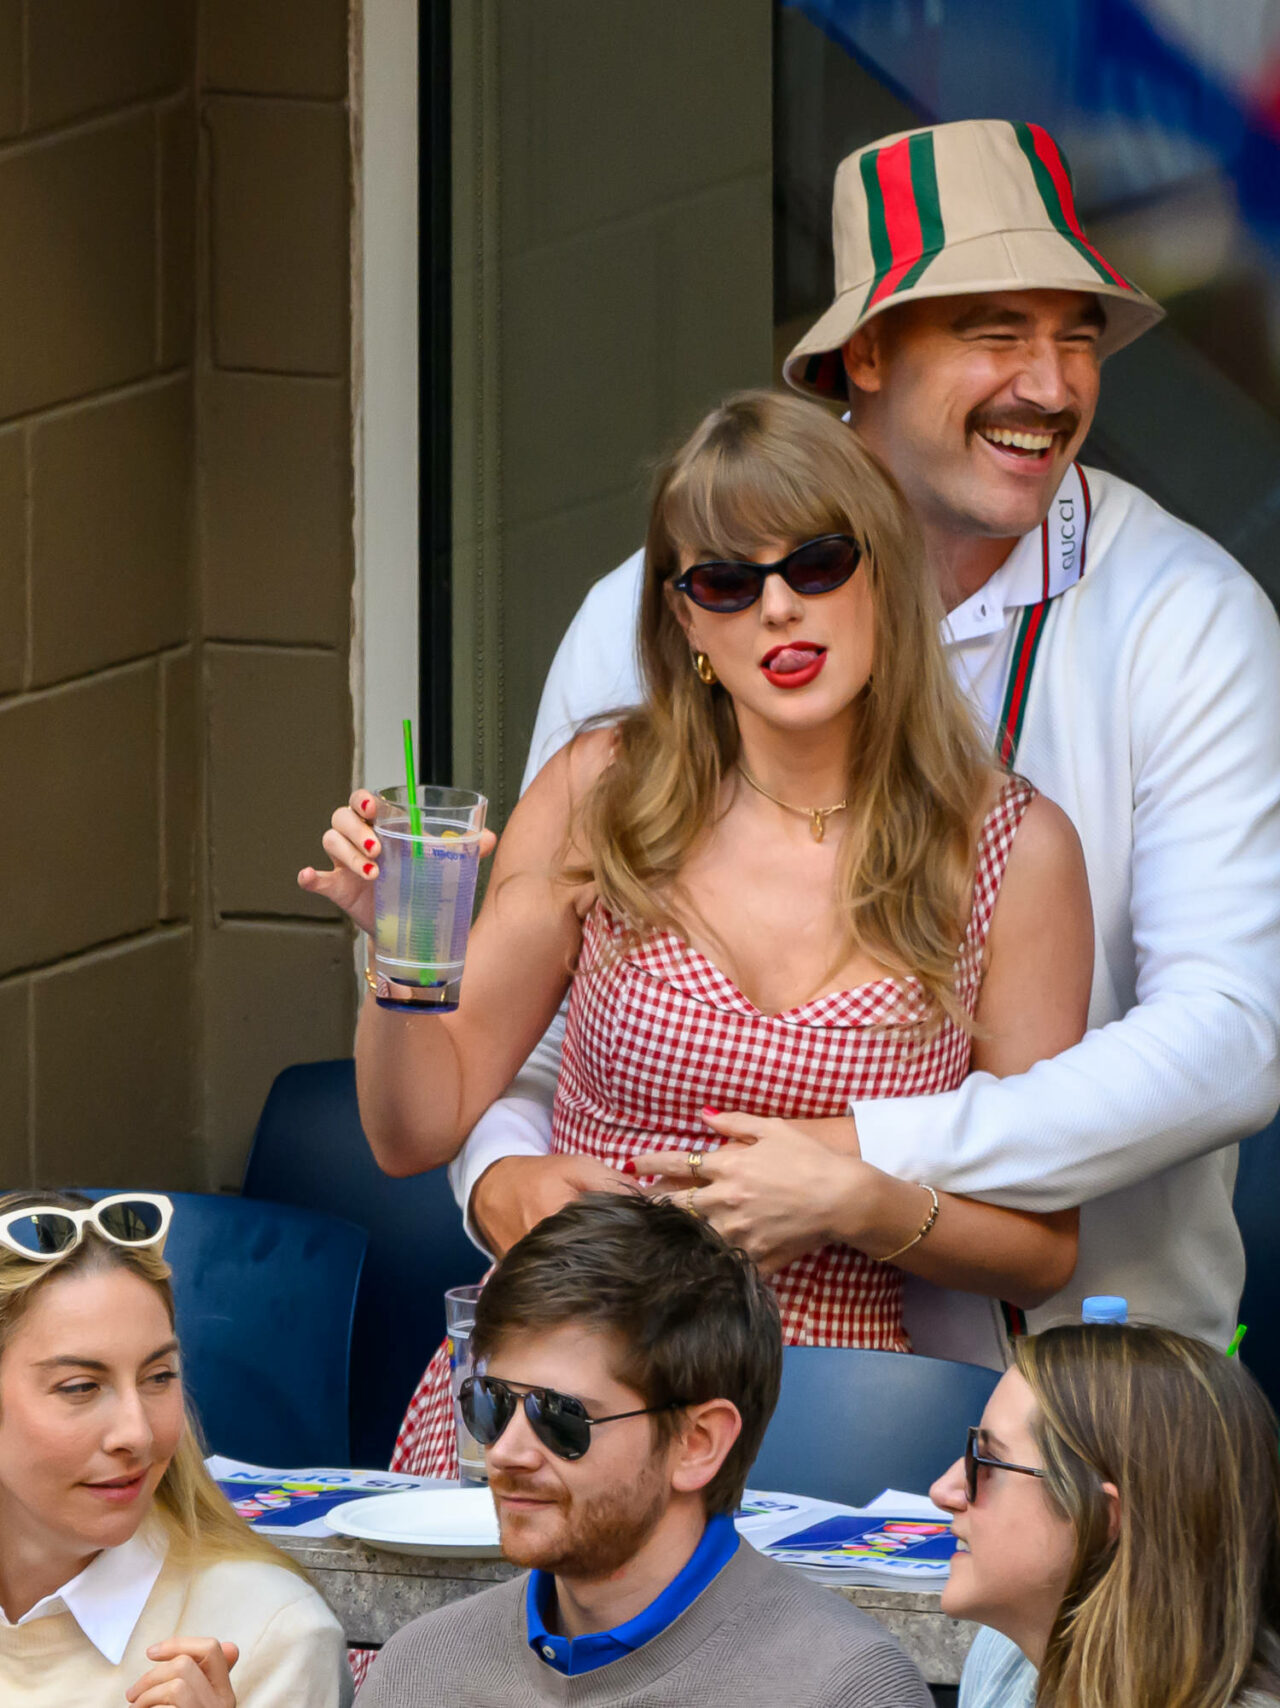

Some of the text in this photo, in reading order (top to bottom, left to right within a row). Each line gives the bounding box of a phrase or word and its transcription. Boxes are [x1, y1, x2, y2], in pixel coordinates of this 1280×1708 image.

[1059, 498, 1076, 570] GUCCI
[228, 1471, 351, 1484] OPEN
[360, 1479, 421, 1490] US
[821, 1555, 947, 1569] OPEN
